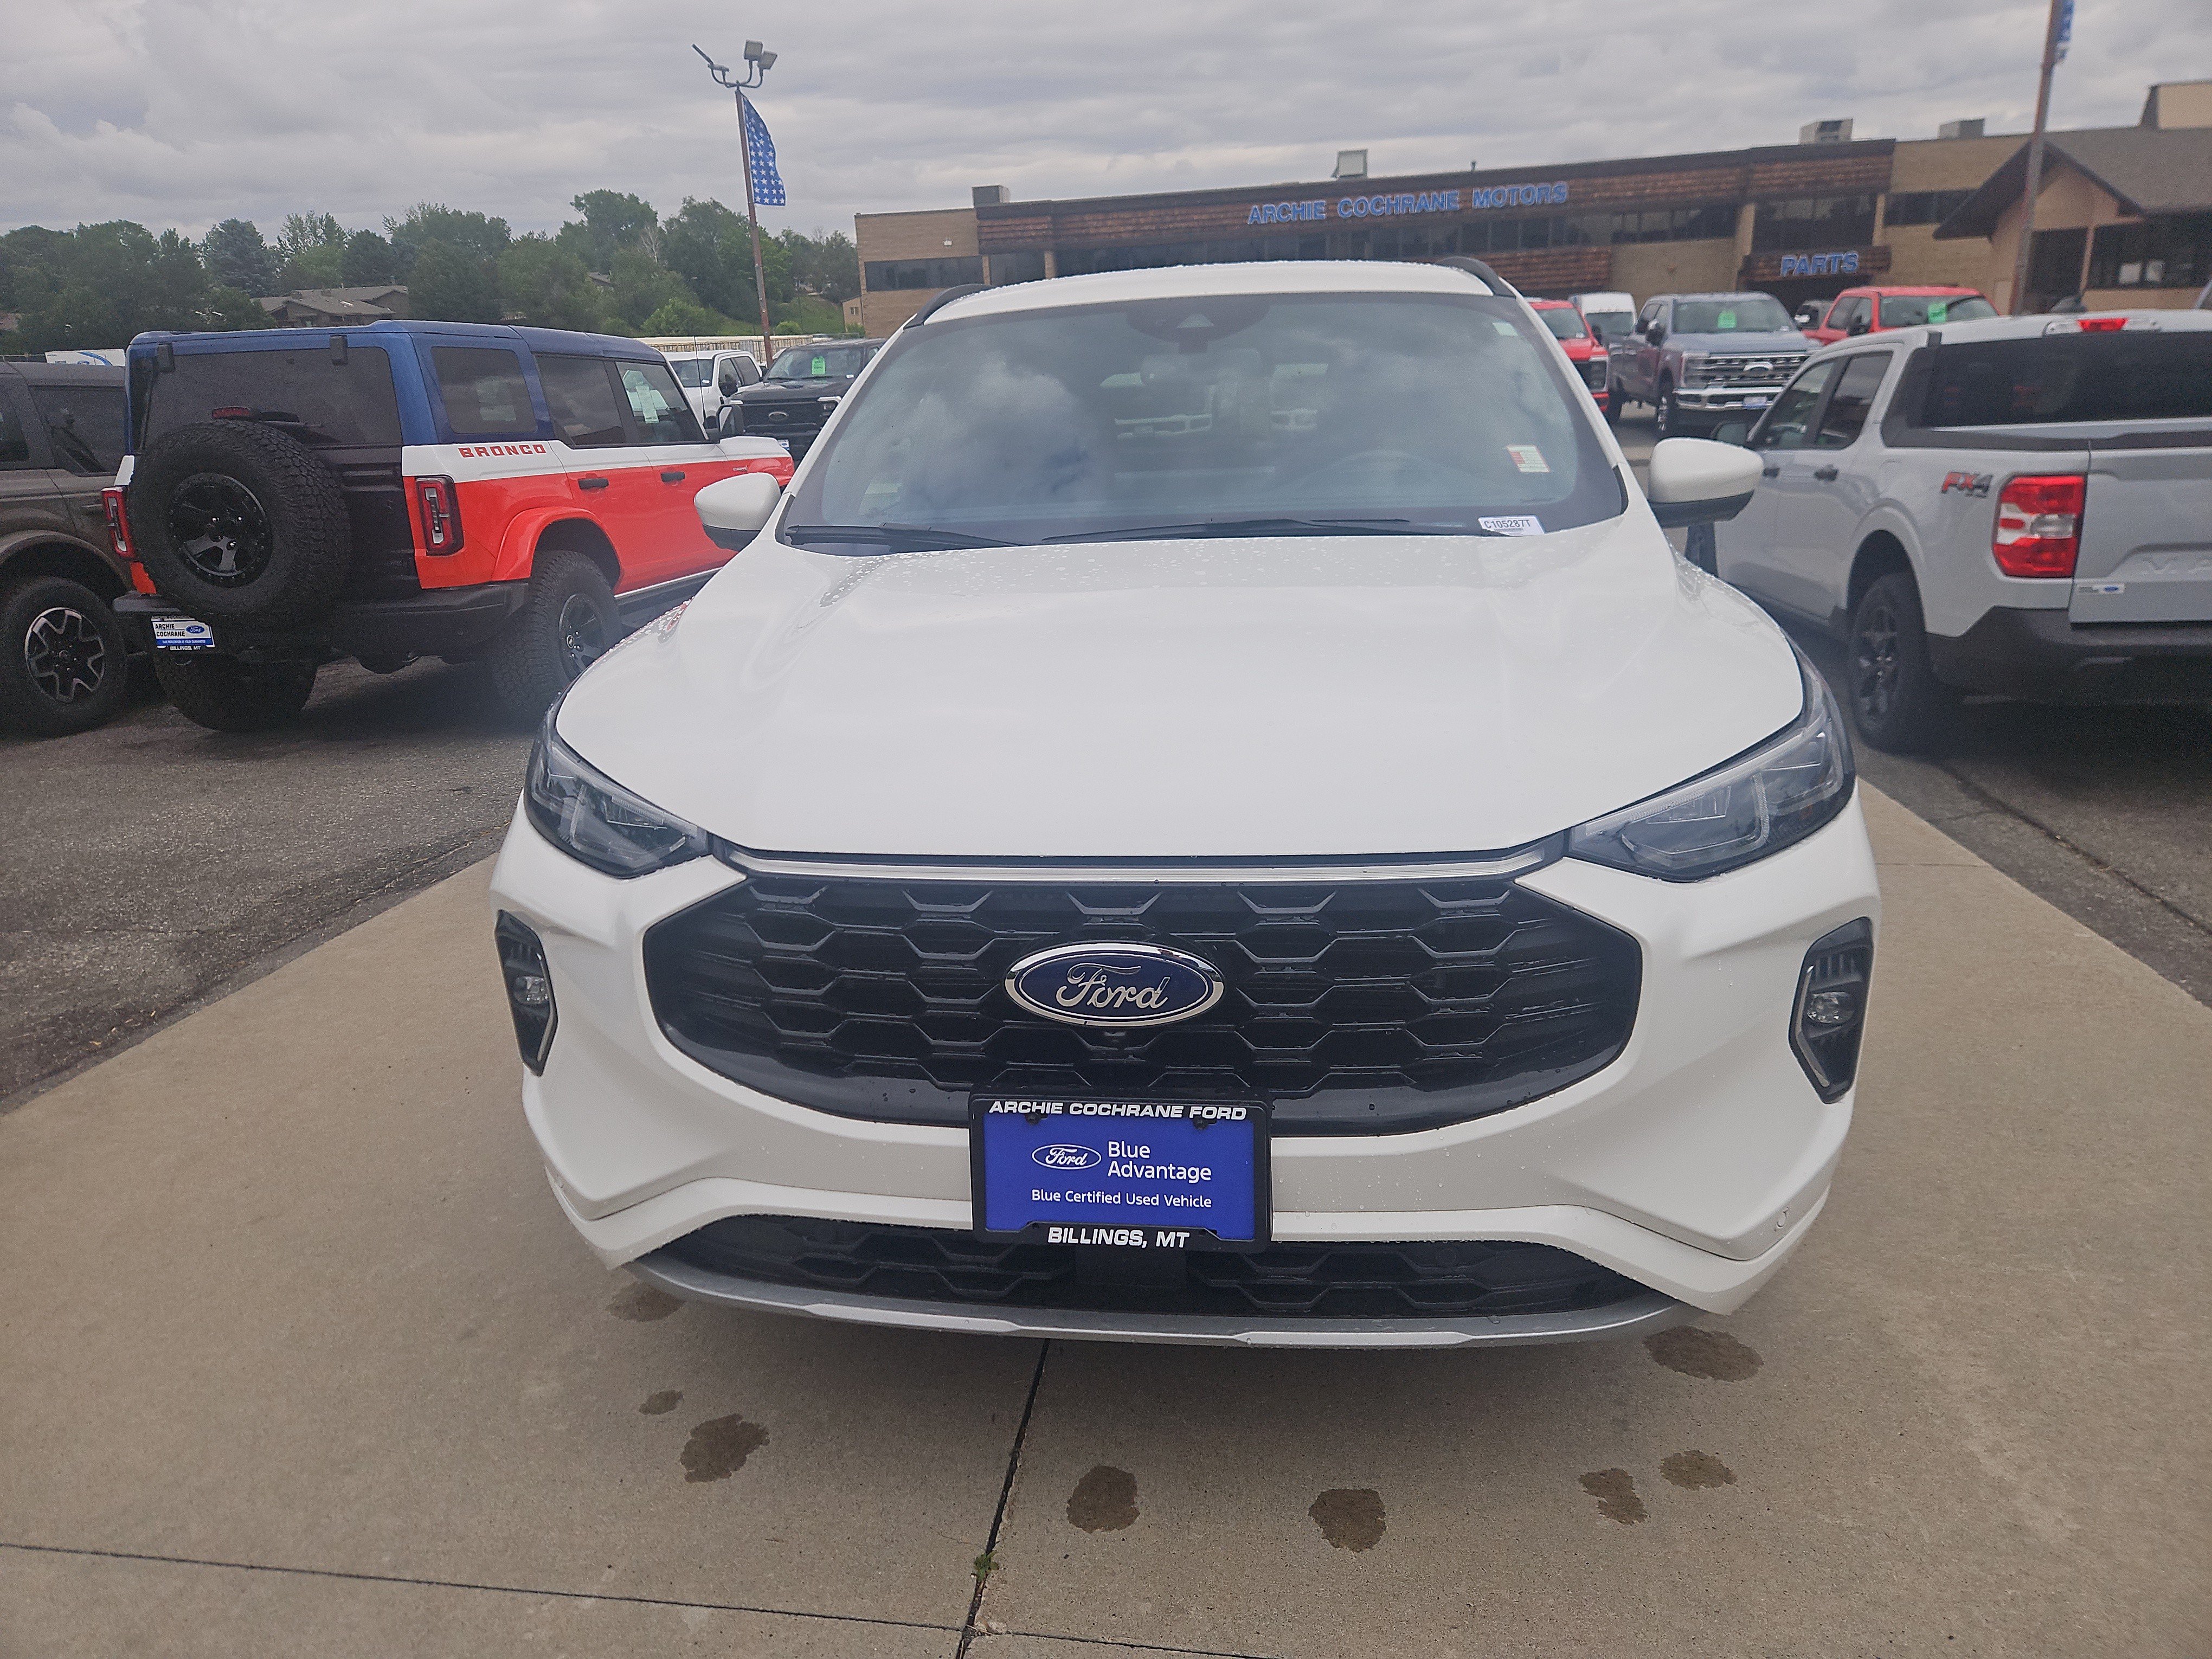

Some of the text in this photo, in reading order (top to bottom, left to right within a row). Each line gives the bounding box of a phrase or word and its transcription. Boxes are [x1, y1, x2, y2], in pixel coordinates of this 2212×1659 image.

[1248, 181, 1568, 225] ARCHIE COCHRANE MOTORS
[1780, 250, 1859, 277] PARTS
[458, 443, 546, 459] BRONCO
[1941, 471, 1994, 493] FX4
[1484, 519, 1531, 529] C105287T
[1056, 962, 1171, 1008] Ford
[988, 1101, 1247, 1121] ARCHIE COCHRANE FORD
[1045, 1147, 1088, 1166] Ford
[1108, 1141, 1150, 1159] Blue
[1107, 1161, 1212, 1184] Advantage
[1032, 1189, 1212, 1208] Blue Certified Used Vehicle
[1047, 1226, 1191, 1249] BILLINGS, MT
